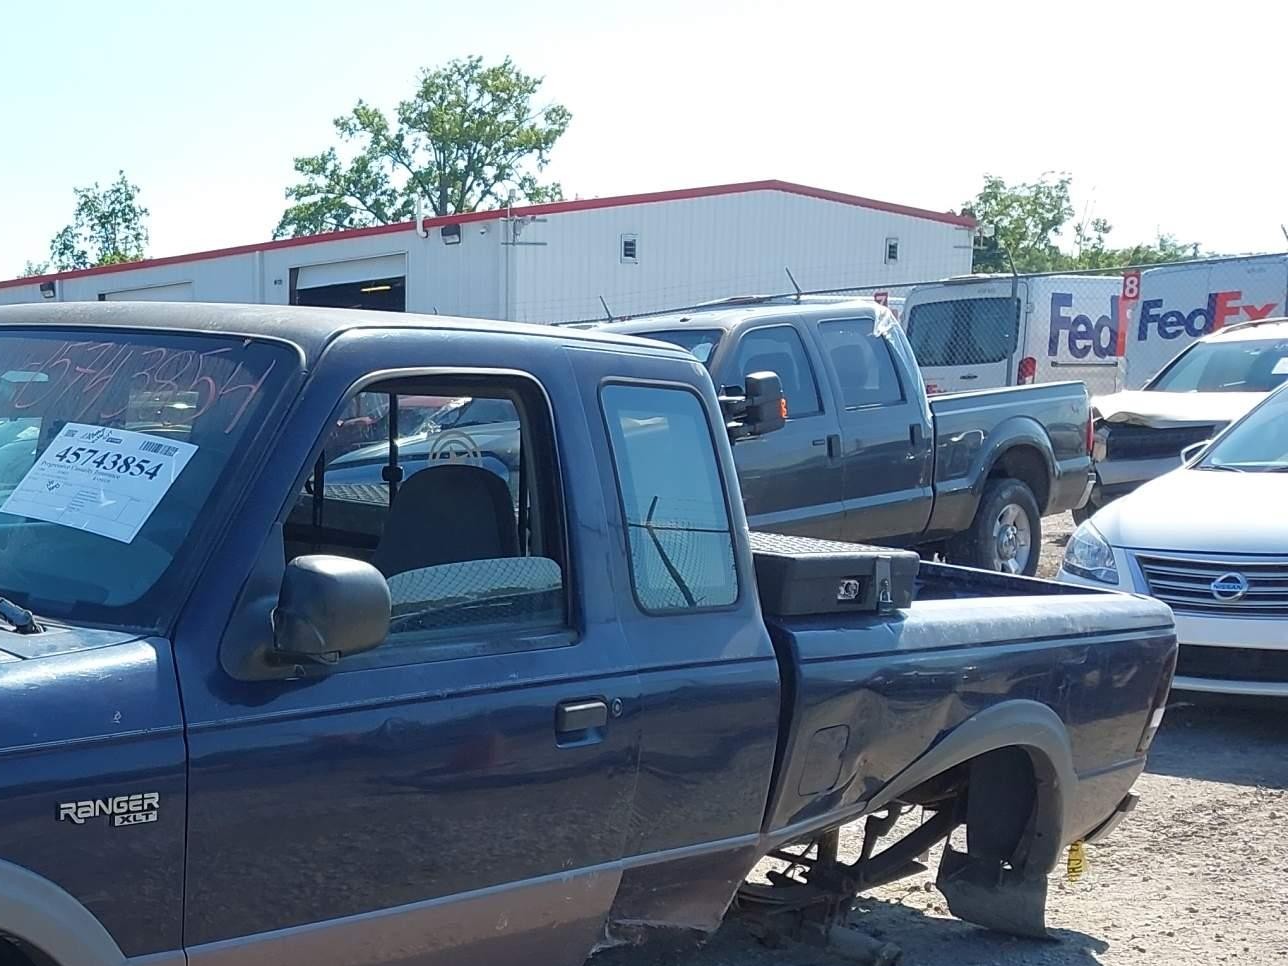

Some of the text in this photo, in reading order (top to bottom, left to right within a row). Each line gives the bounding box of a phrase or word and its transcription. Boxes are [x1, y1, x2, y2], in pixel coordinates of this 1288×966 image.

[1124, 276, 1138, 298] 8
[55, 446, 163, 481] 45743854
[59, 792, 159, 824] RANGER
[117, 812, 155, 825] XLT
